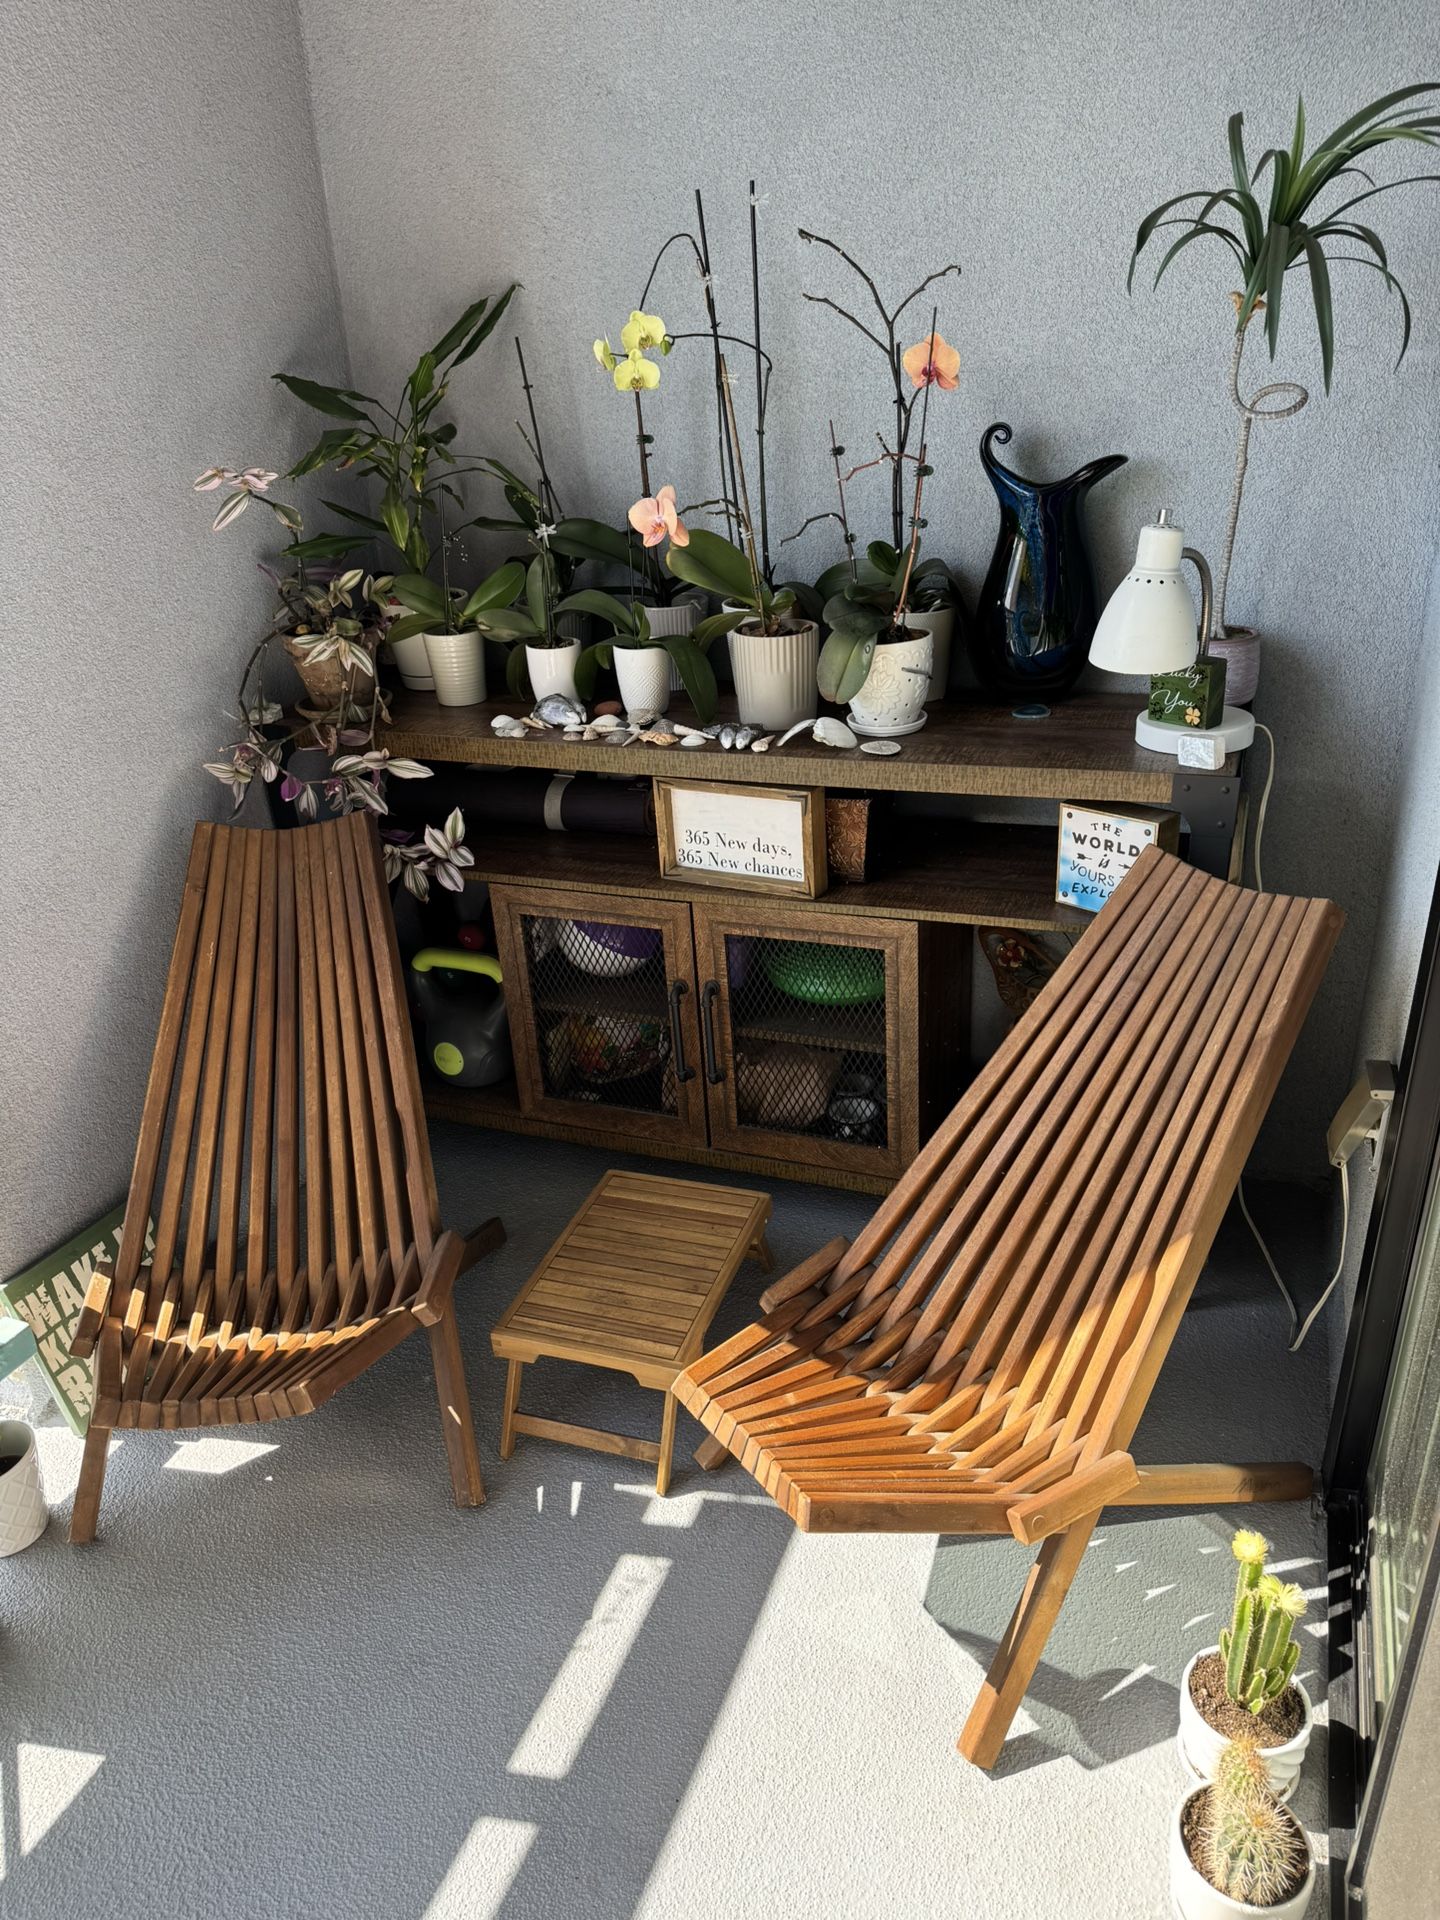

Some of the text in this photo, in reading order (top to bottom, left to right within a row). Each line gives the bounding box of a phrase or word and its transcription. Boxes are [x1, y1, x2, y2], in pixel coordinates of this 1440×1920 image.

[1151, 689, 1196, 714] You
[1091, 823, 1122, 837] THE
[685, 828, 792, 860] 365 New days,
[1072, 832, 1140, 857] WORLD
[678, 848, 803, 878] 365 New chances
[1070, 860, 1115, 887] YOURS
[1098, 854, 1110, 869] is
